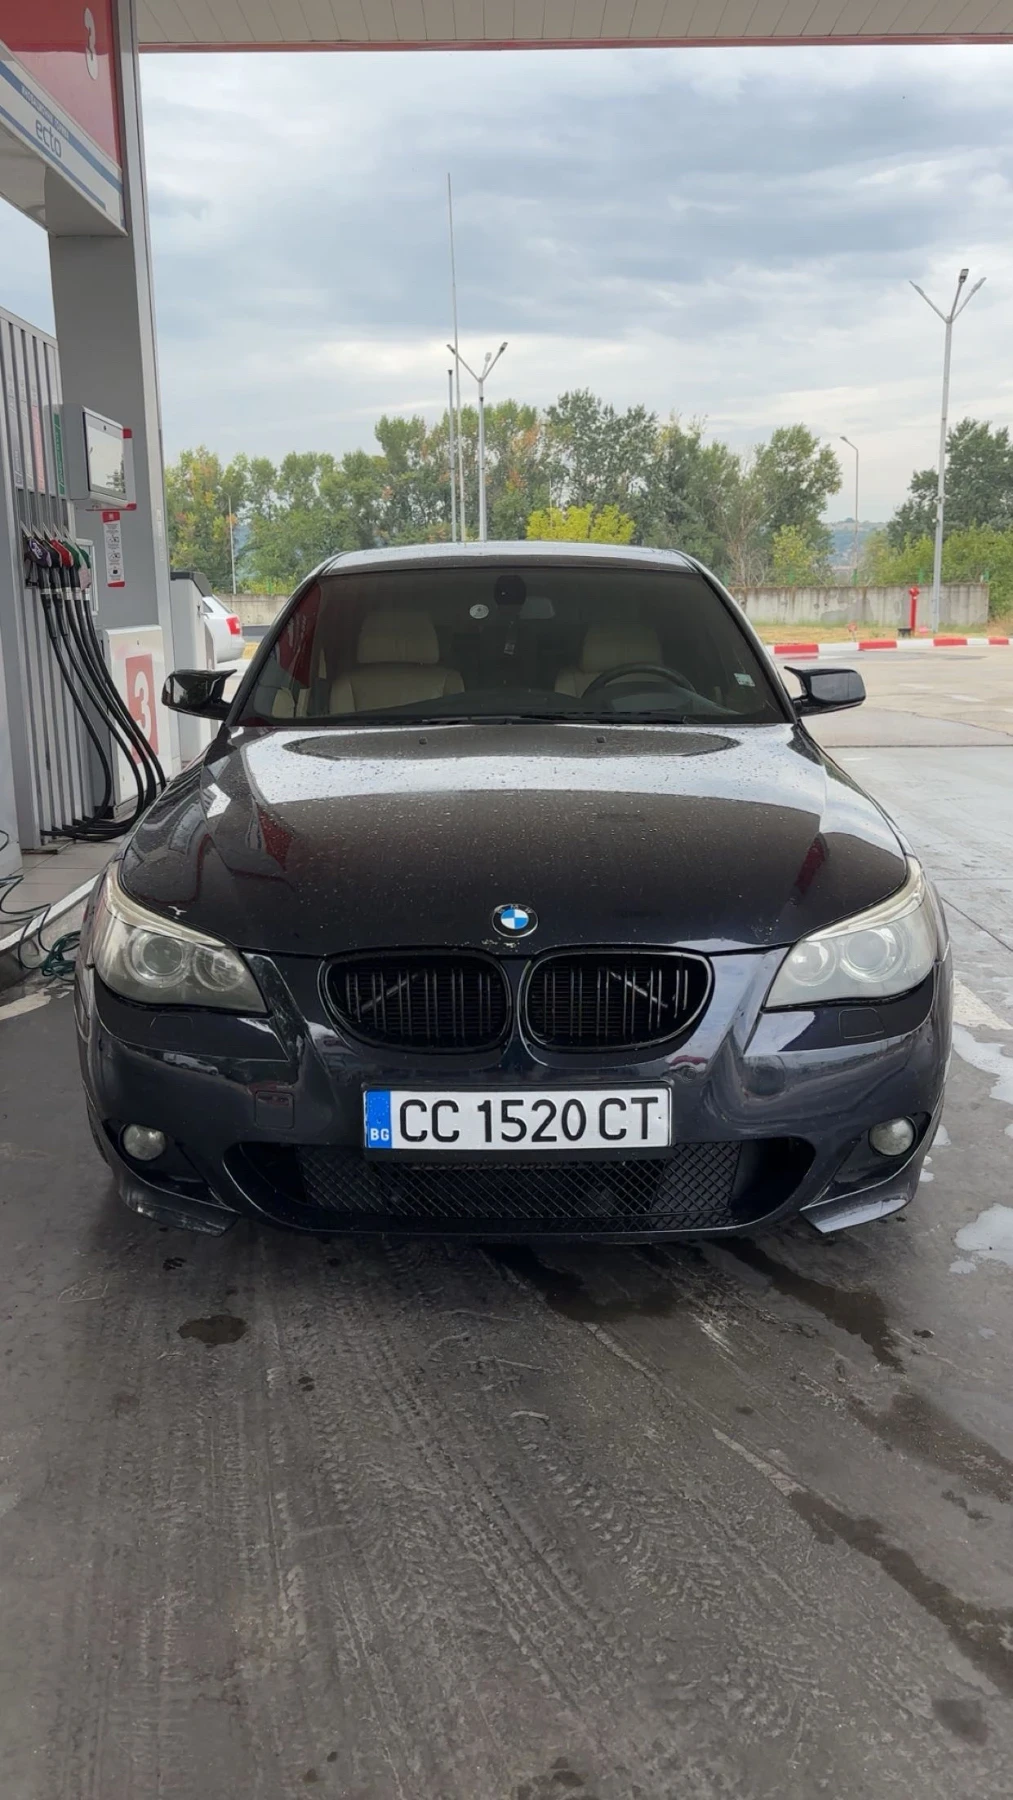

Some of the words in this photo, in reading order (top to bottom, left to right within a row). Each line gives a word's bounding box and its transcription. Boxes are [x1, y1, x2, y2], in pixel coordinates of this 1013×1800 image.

[84, 7, 97, 80] 3
[35, 119, 62, 158] ecto
[134, 671, 152, 740] 3
[370, 1128, 390, 1142] BG
[399, 1099, 460, 1143] CC
[477, 1098, 587, 1143] 1520
[598, 1097, 659, 1141] CT
